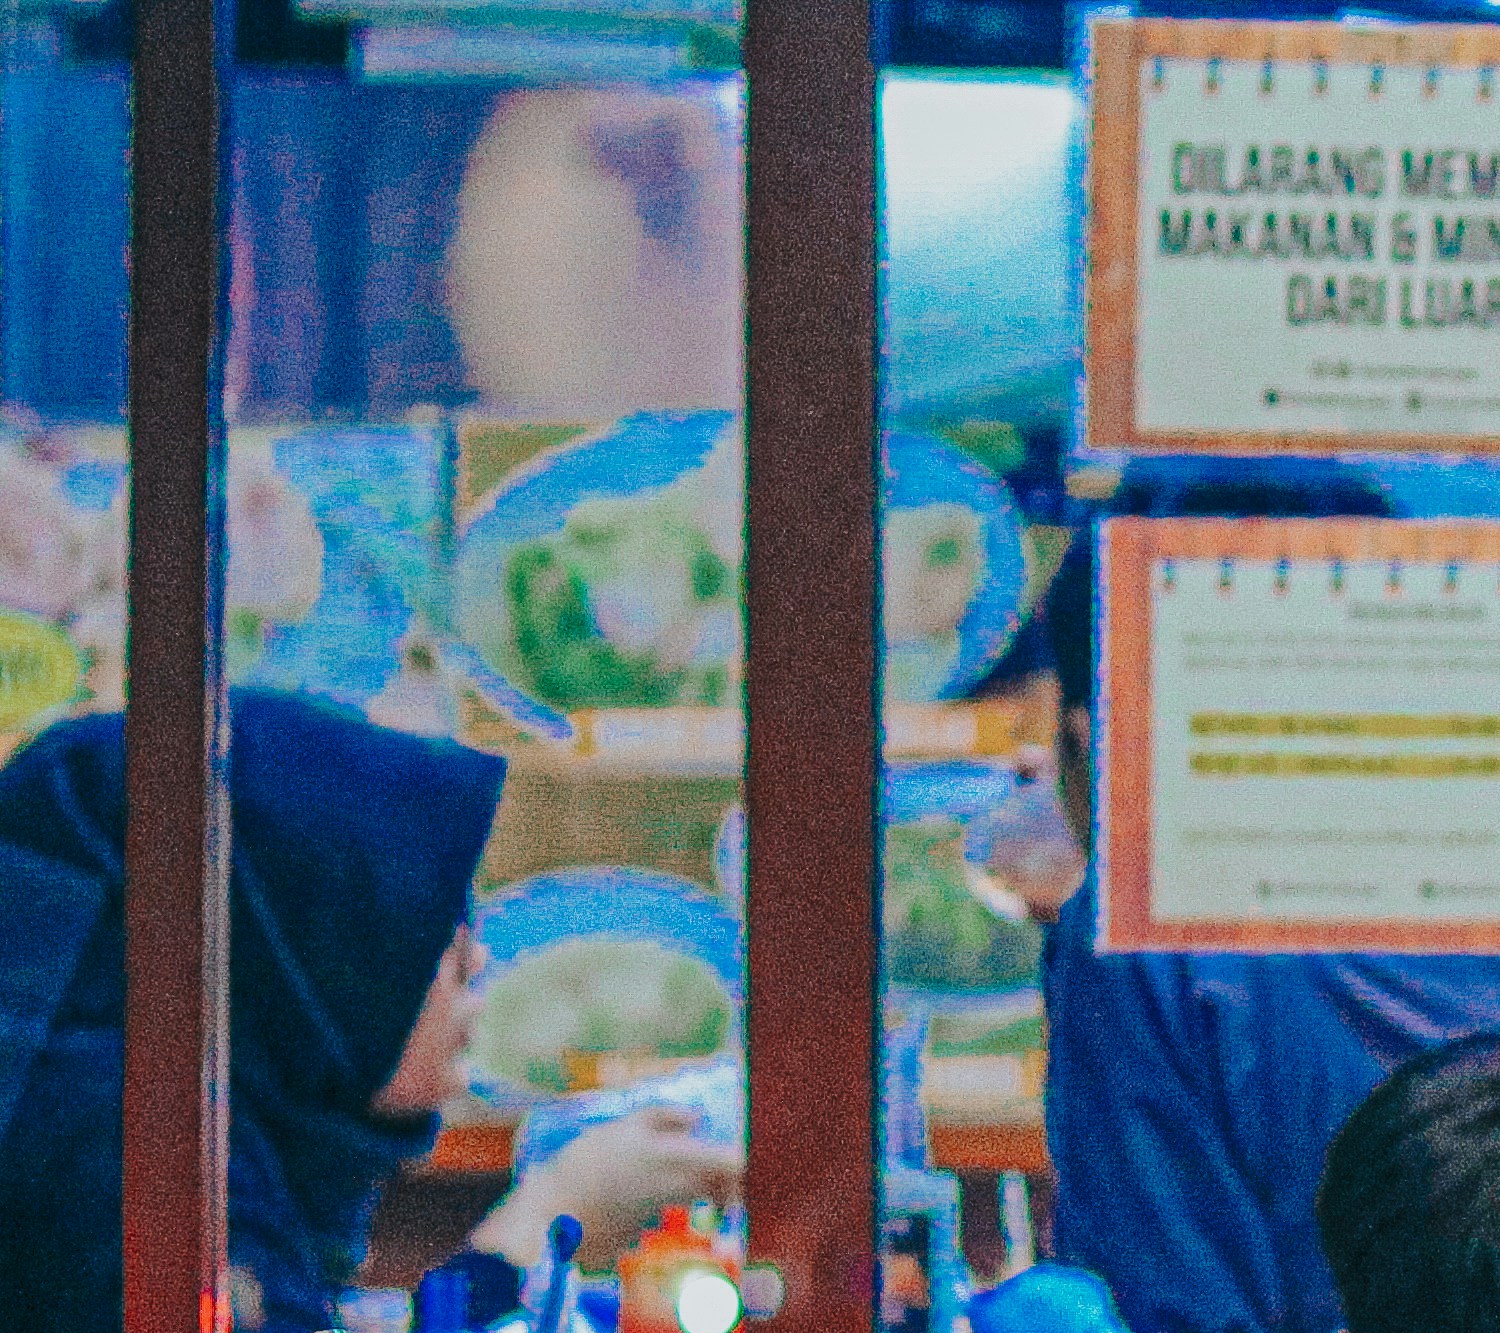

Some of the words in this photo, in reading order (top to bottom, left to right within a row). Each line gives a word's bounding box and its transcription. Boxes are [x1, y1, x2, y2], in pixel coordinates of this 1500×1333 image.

[1172, 142, 1384, 199] DILARANG
[1158, 206, 1376, 263] MAKANAN
[1287, 273, 1387, 328] DARI
